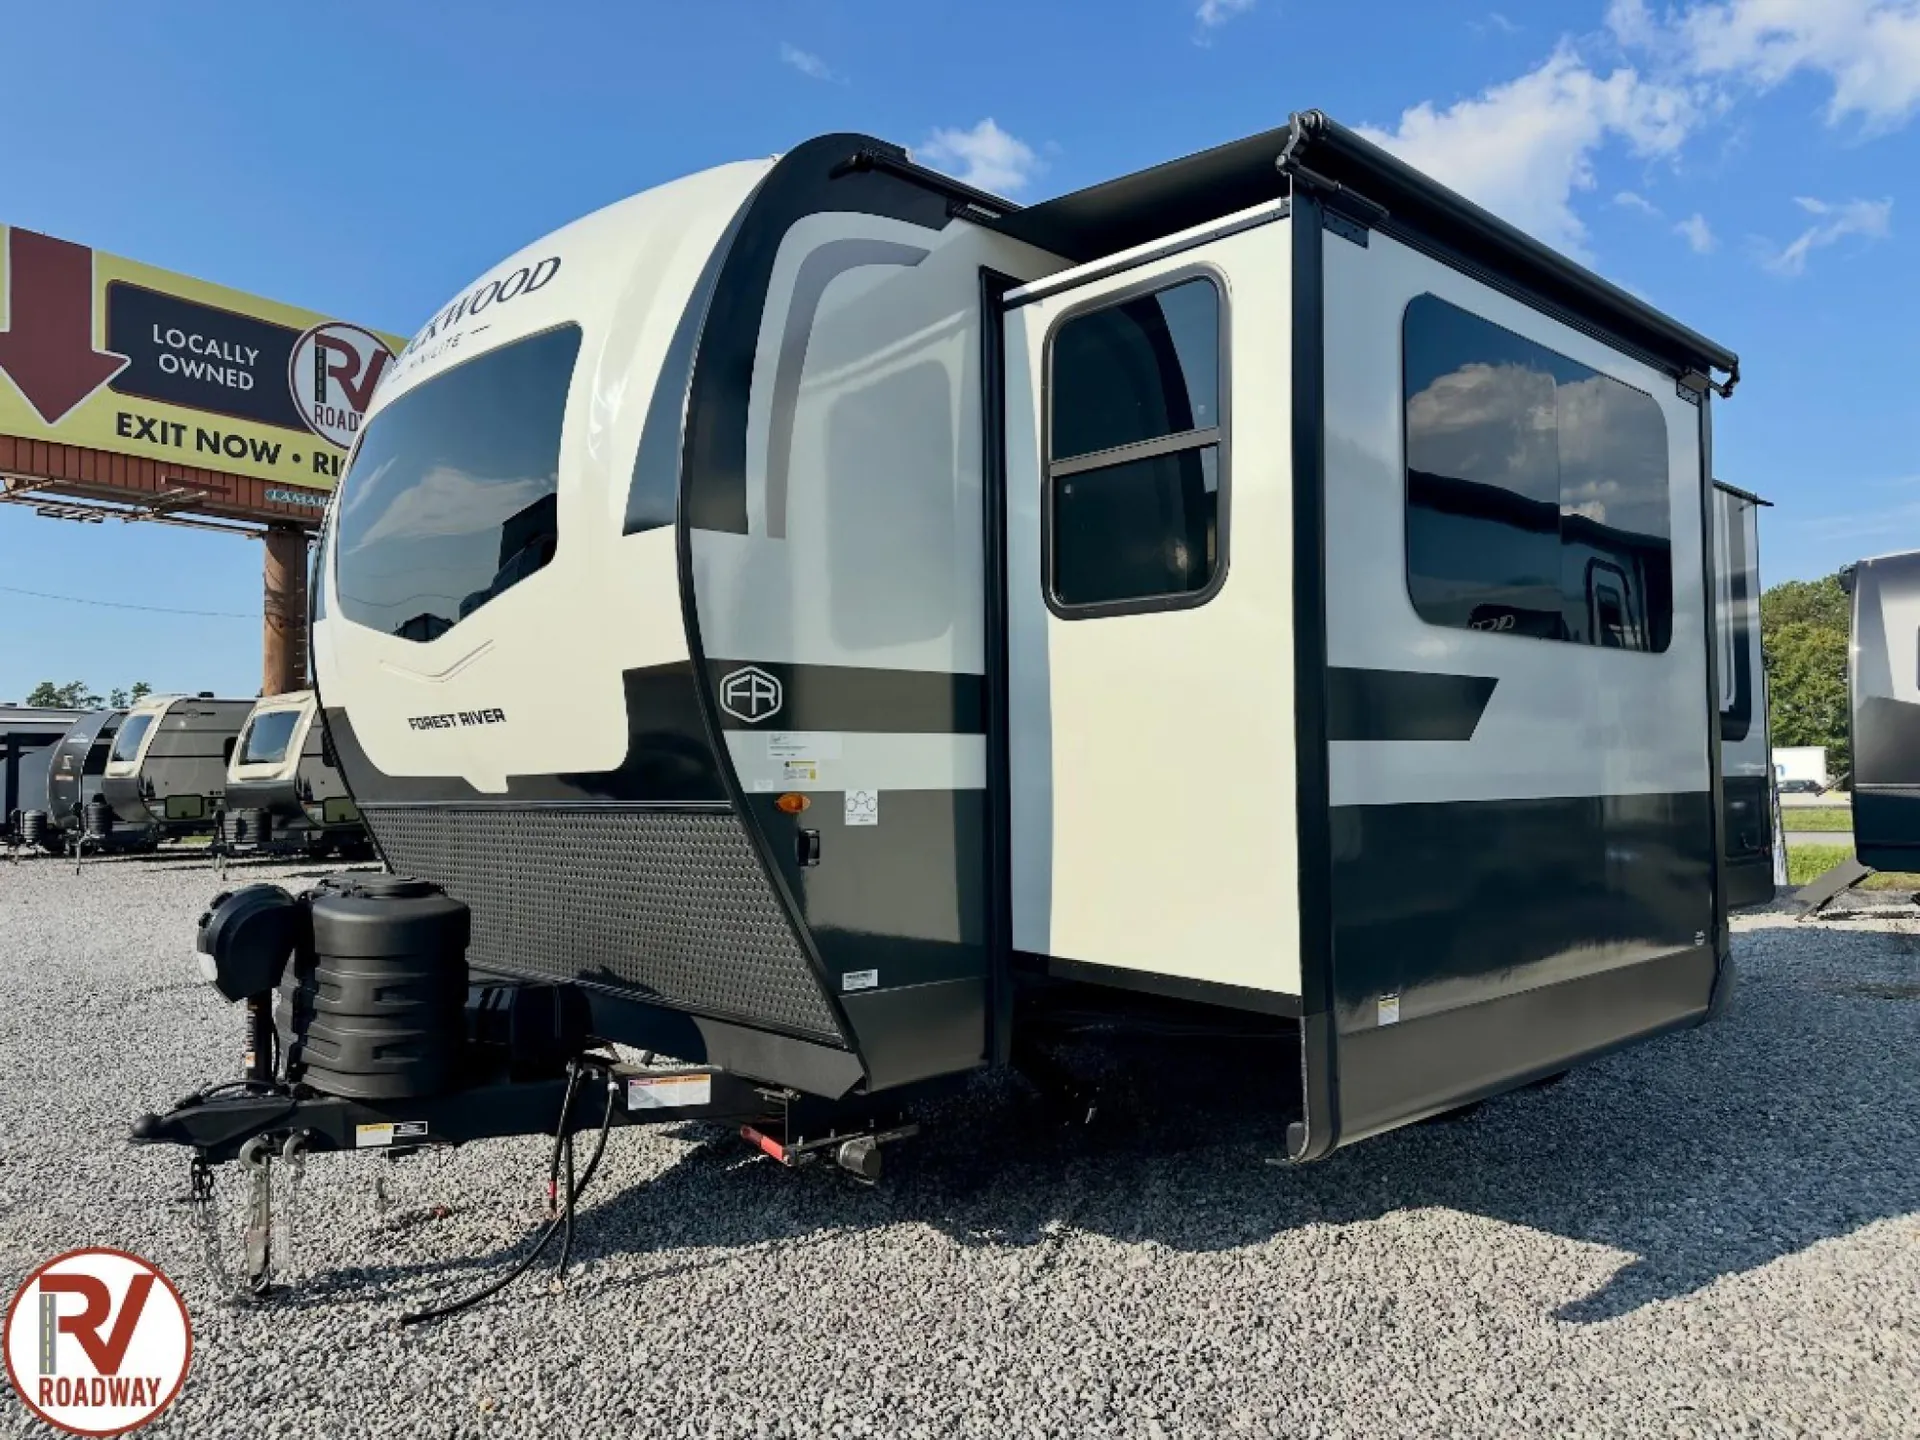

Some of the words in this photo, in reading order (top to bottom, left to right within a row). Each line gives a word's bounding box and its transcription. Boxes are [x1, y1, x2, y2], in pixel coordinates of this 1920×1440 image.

[153, 324, 259, 367] LOCALLY
[159, 353, 254, 391] OWNED
[314, 333, 388, 413] RV
[314, 404, 363, 432] ROAD
[116, 411, 187, 448] EXIT
[196, 427, 282, 465] NOW
[312, 451, 347, 477] RI
[407, 713, 456, 730] FOREST
[457, 707, 507, 727] RIVER
